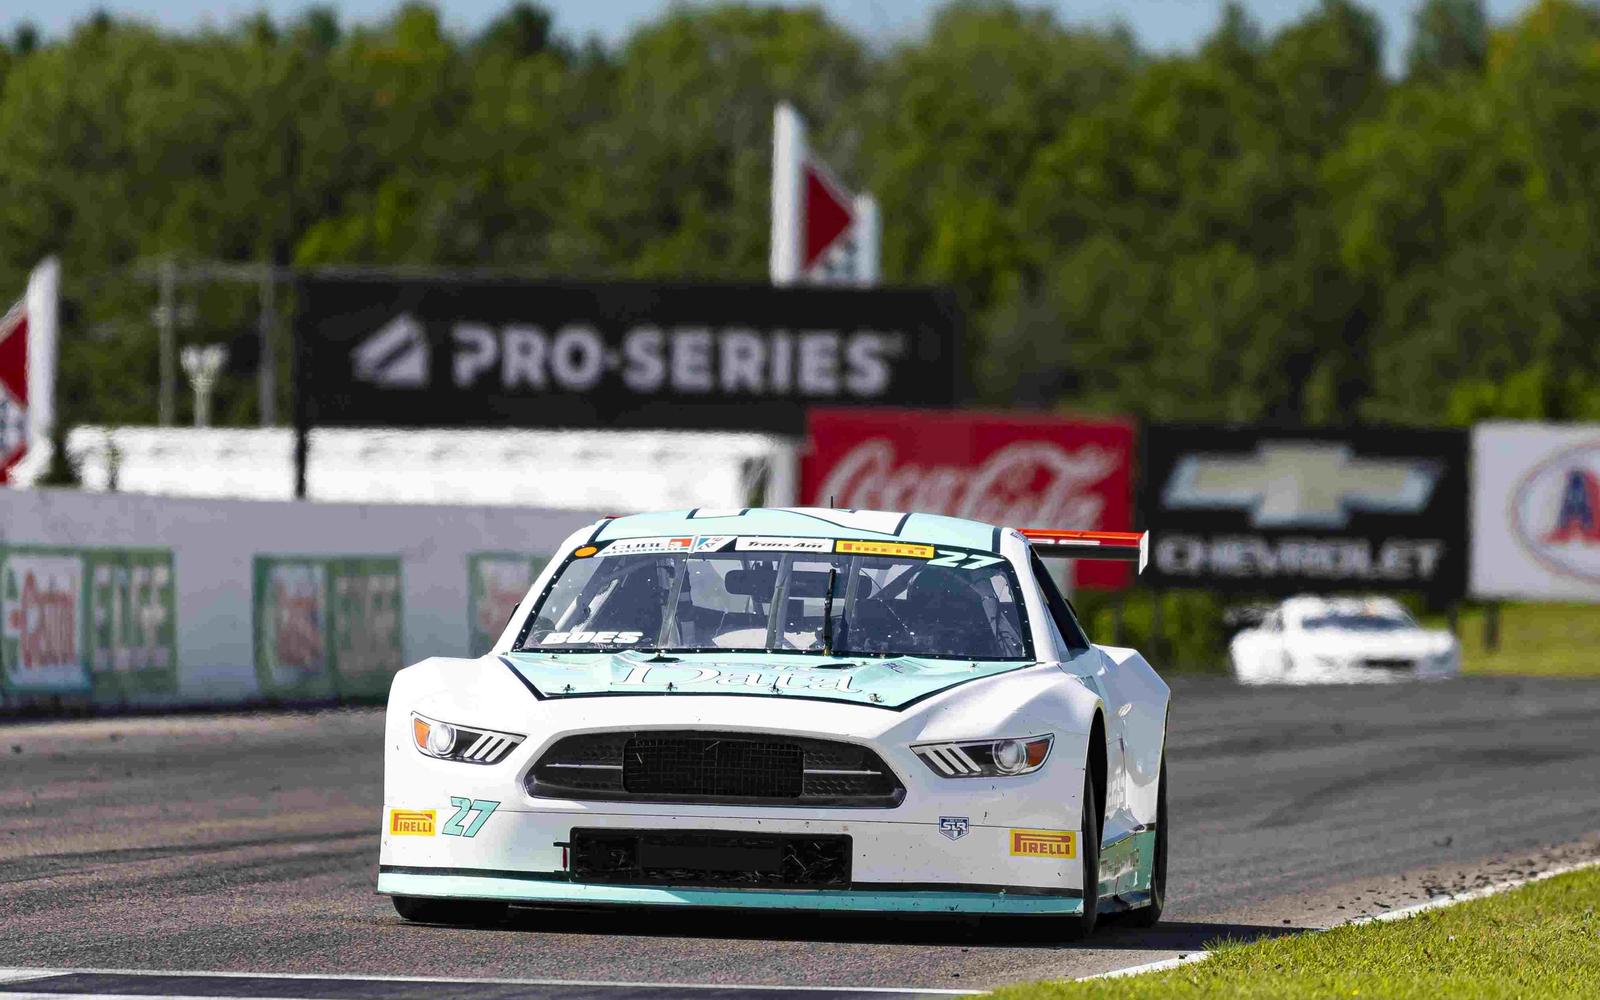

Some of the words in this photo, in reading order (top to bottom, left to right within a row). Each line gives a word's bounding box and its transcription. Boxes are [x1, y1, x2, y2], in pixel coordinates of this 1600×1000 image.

[451, 324, 890, 394] PRO-SERIES
[796, 541, 824, 549] Am
[928, 550, 1006, 570] 27
[1154, 538, 1442, 579] CHEVROLET
[393, 813, 433, 832] PIRELLI
[442, 796, 501, 838] 27
[1014, 833, 1071, 855] PIRELLI
